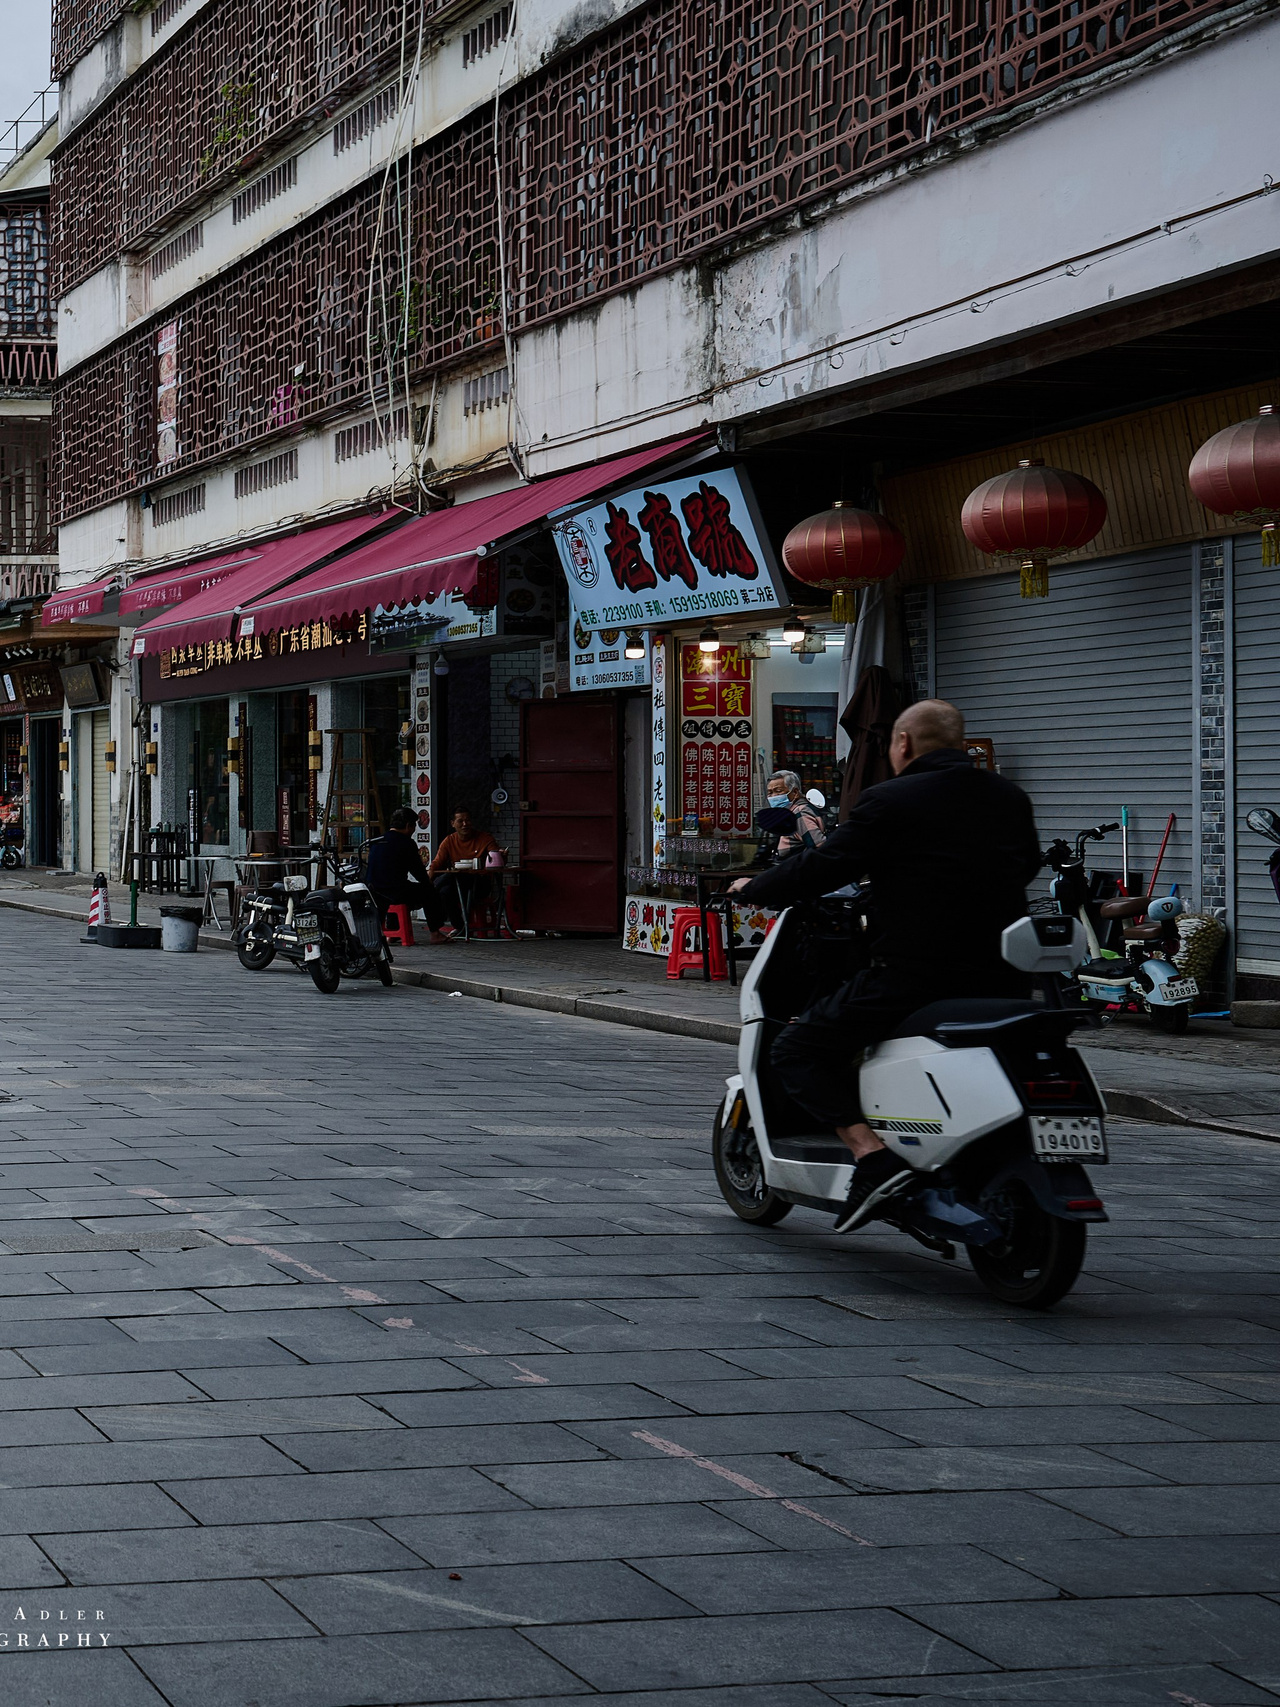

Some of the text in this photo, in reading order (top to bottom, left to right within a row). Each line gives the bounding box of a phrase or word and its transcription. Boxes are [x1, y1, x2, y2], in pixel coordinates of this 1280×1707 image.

[602, 603, 643, 623] 2239100
[669, 589, 739, 613] 15919518069
[740, 586, 775, 605] 第二分店
[447, 623, 478, 637] 13060537355
[592, 671, 634, 685] 13060537355
[686, 650, 746, 678] 潮州
[686, 683, 745, 716] 三寶
[653, 689, 666, 802] 祖傳四老
[685, 748, 698, 815] 佛手老香
[719, 749, 732, 825] 九制老陈皮
[736, 749, 749, 825] 古制老黄皮
[1163, 985, 1197, 999] 192895
[1037, 1134, 1101, 1151] 194019
